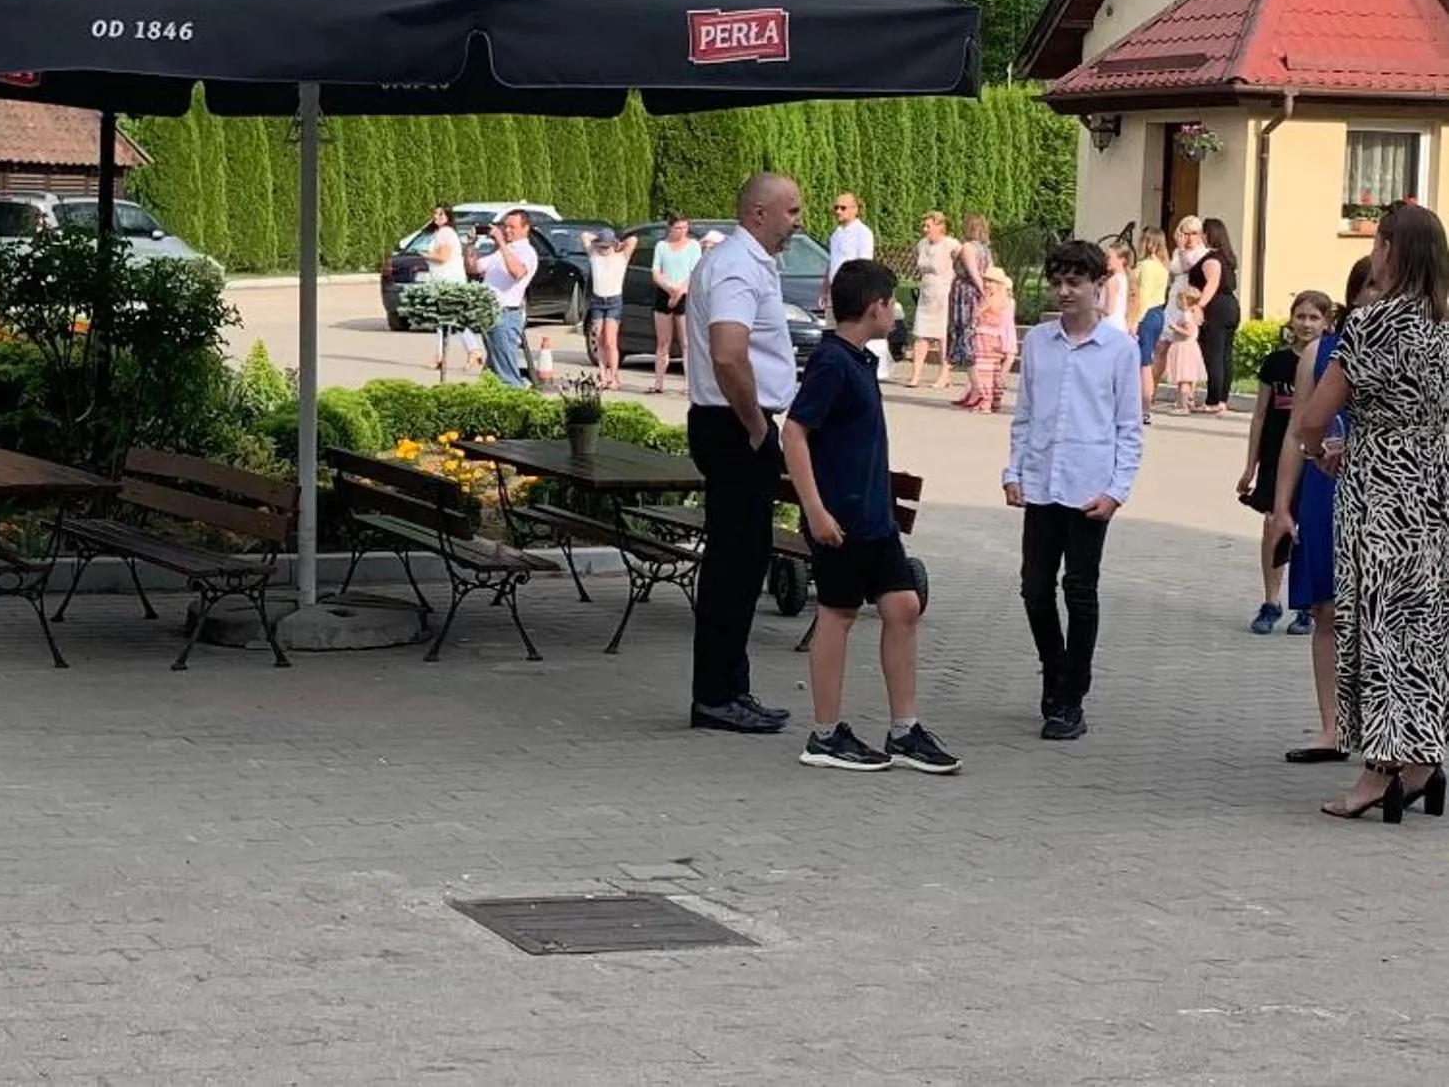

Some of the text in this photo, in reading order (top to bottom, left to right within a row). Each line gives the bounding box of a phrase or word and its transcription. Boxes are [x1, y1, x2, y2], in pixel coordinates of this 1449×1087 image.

[92, 19, 193, 41] OD 1846
[699, 20, 779, 50] PERŁA
